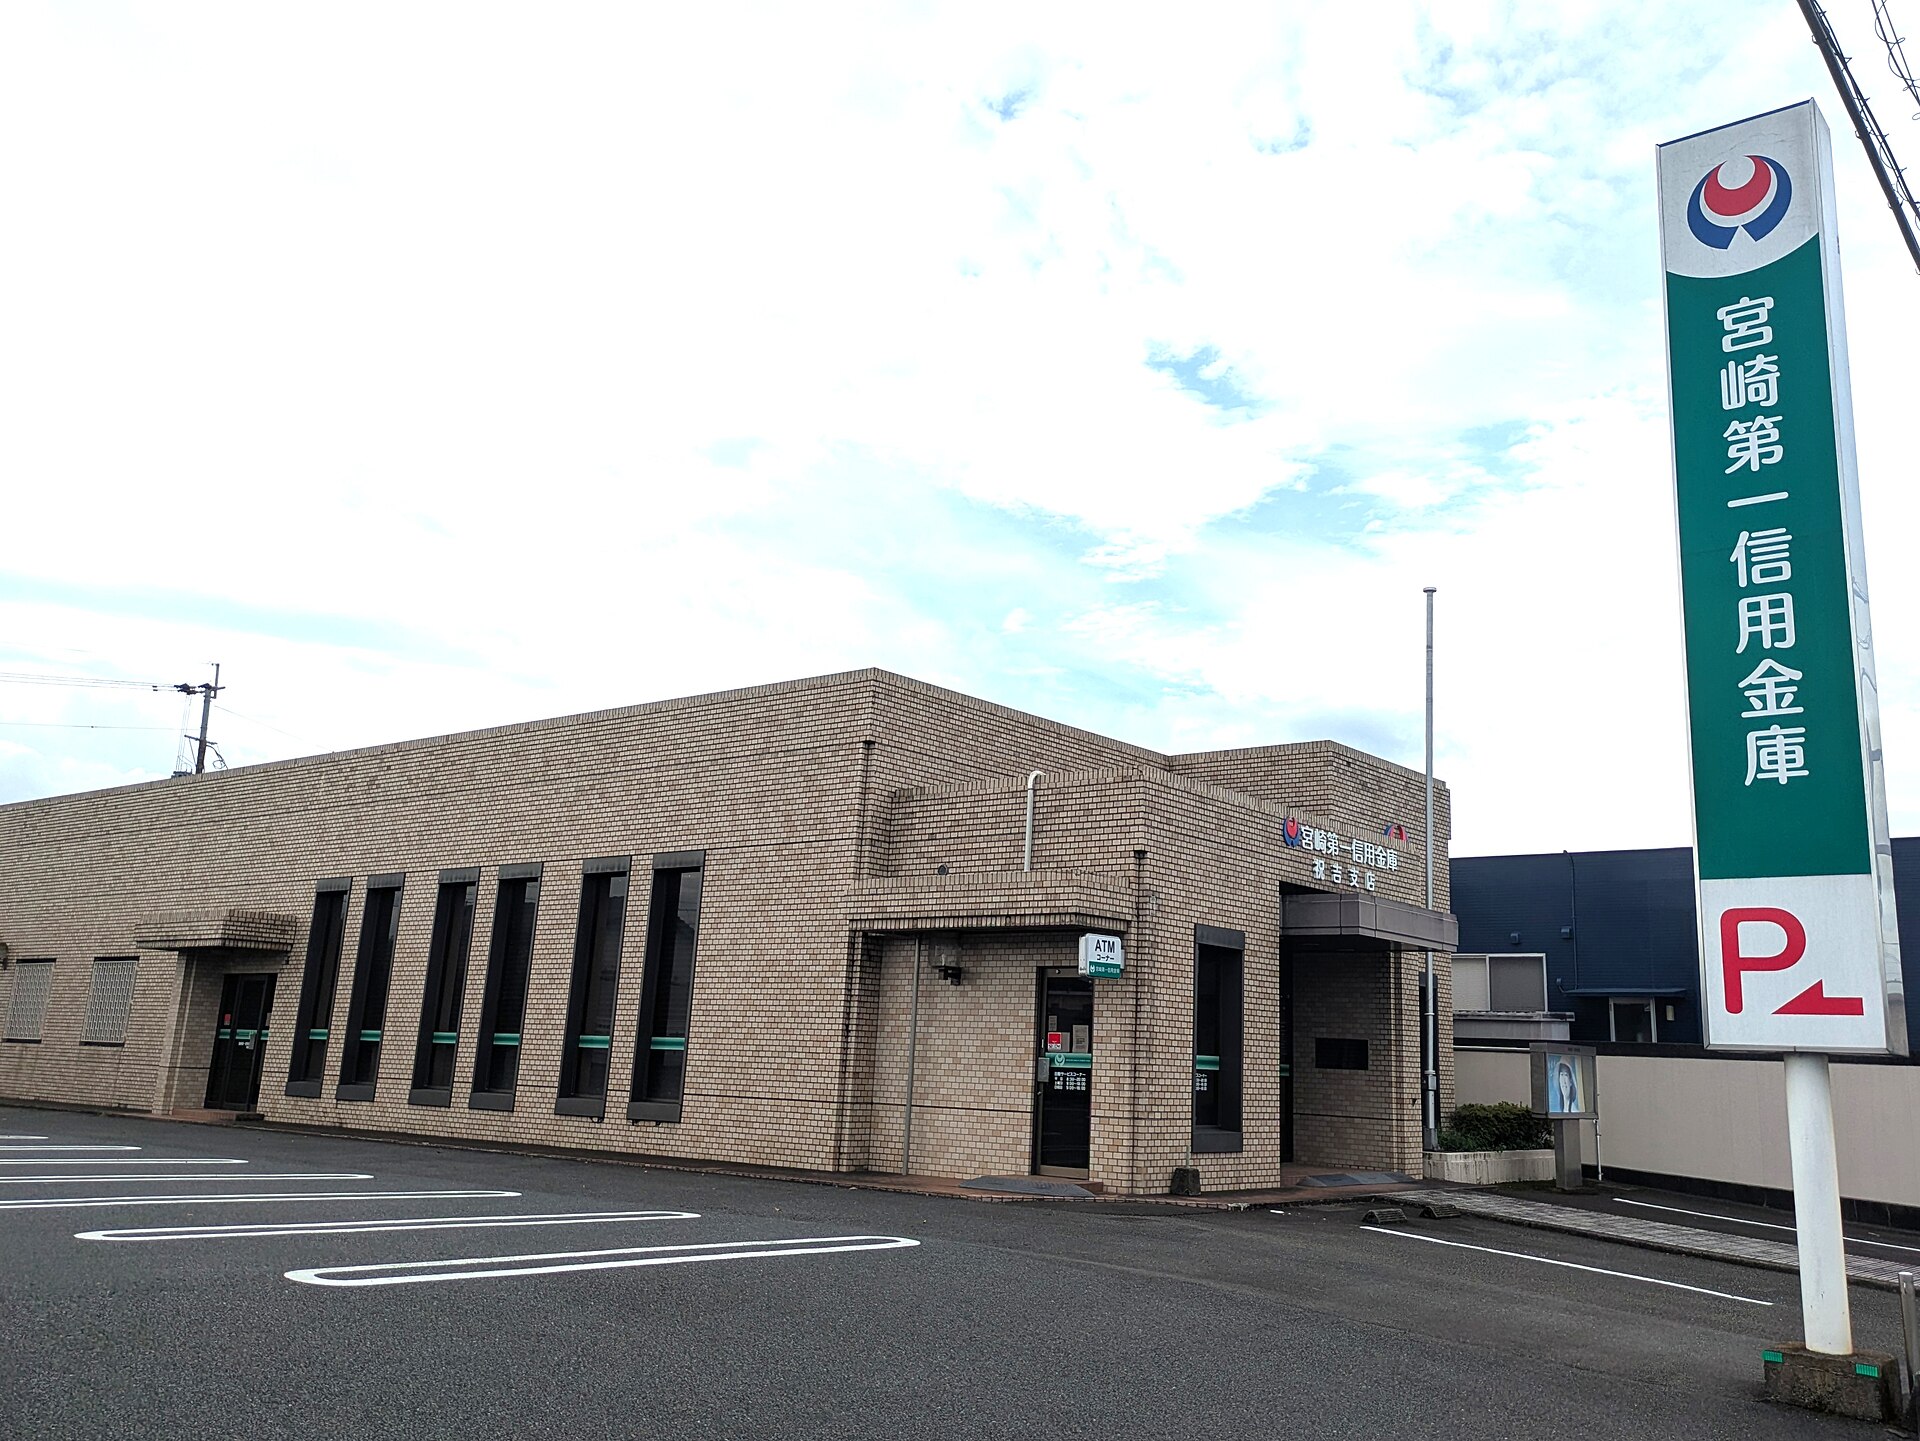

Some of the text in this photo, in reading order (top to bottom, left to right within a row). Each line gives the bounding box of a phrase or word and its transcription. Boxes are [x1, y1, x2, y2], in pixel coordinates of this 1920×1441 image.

[1716, 296, 1810, 786] 宮崎第一信用金庫
[1301, 825, 1398, 872] 宮崎第一信用金庫
[1094, 939, 1115, 954] ATM
[1096, 953, 1115, 962] コーナー
[1720, 907, 1806, 1014] P
